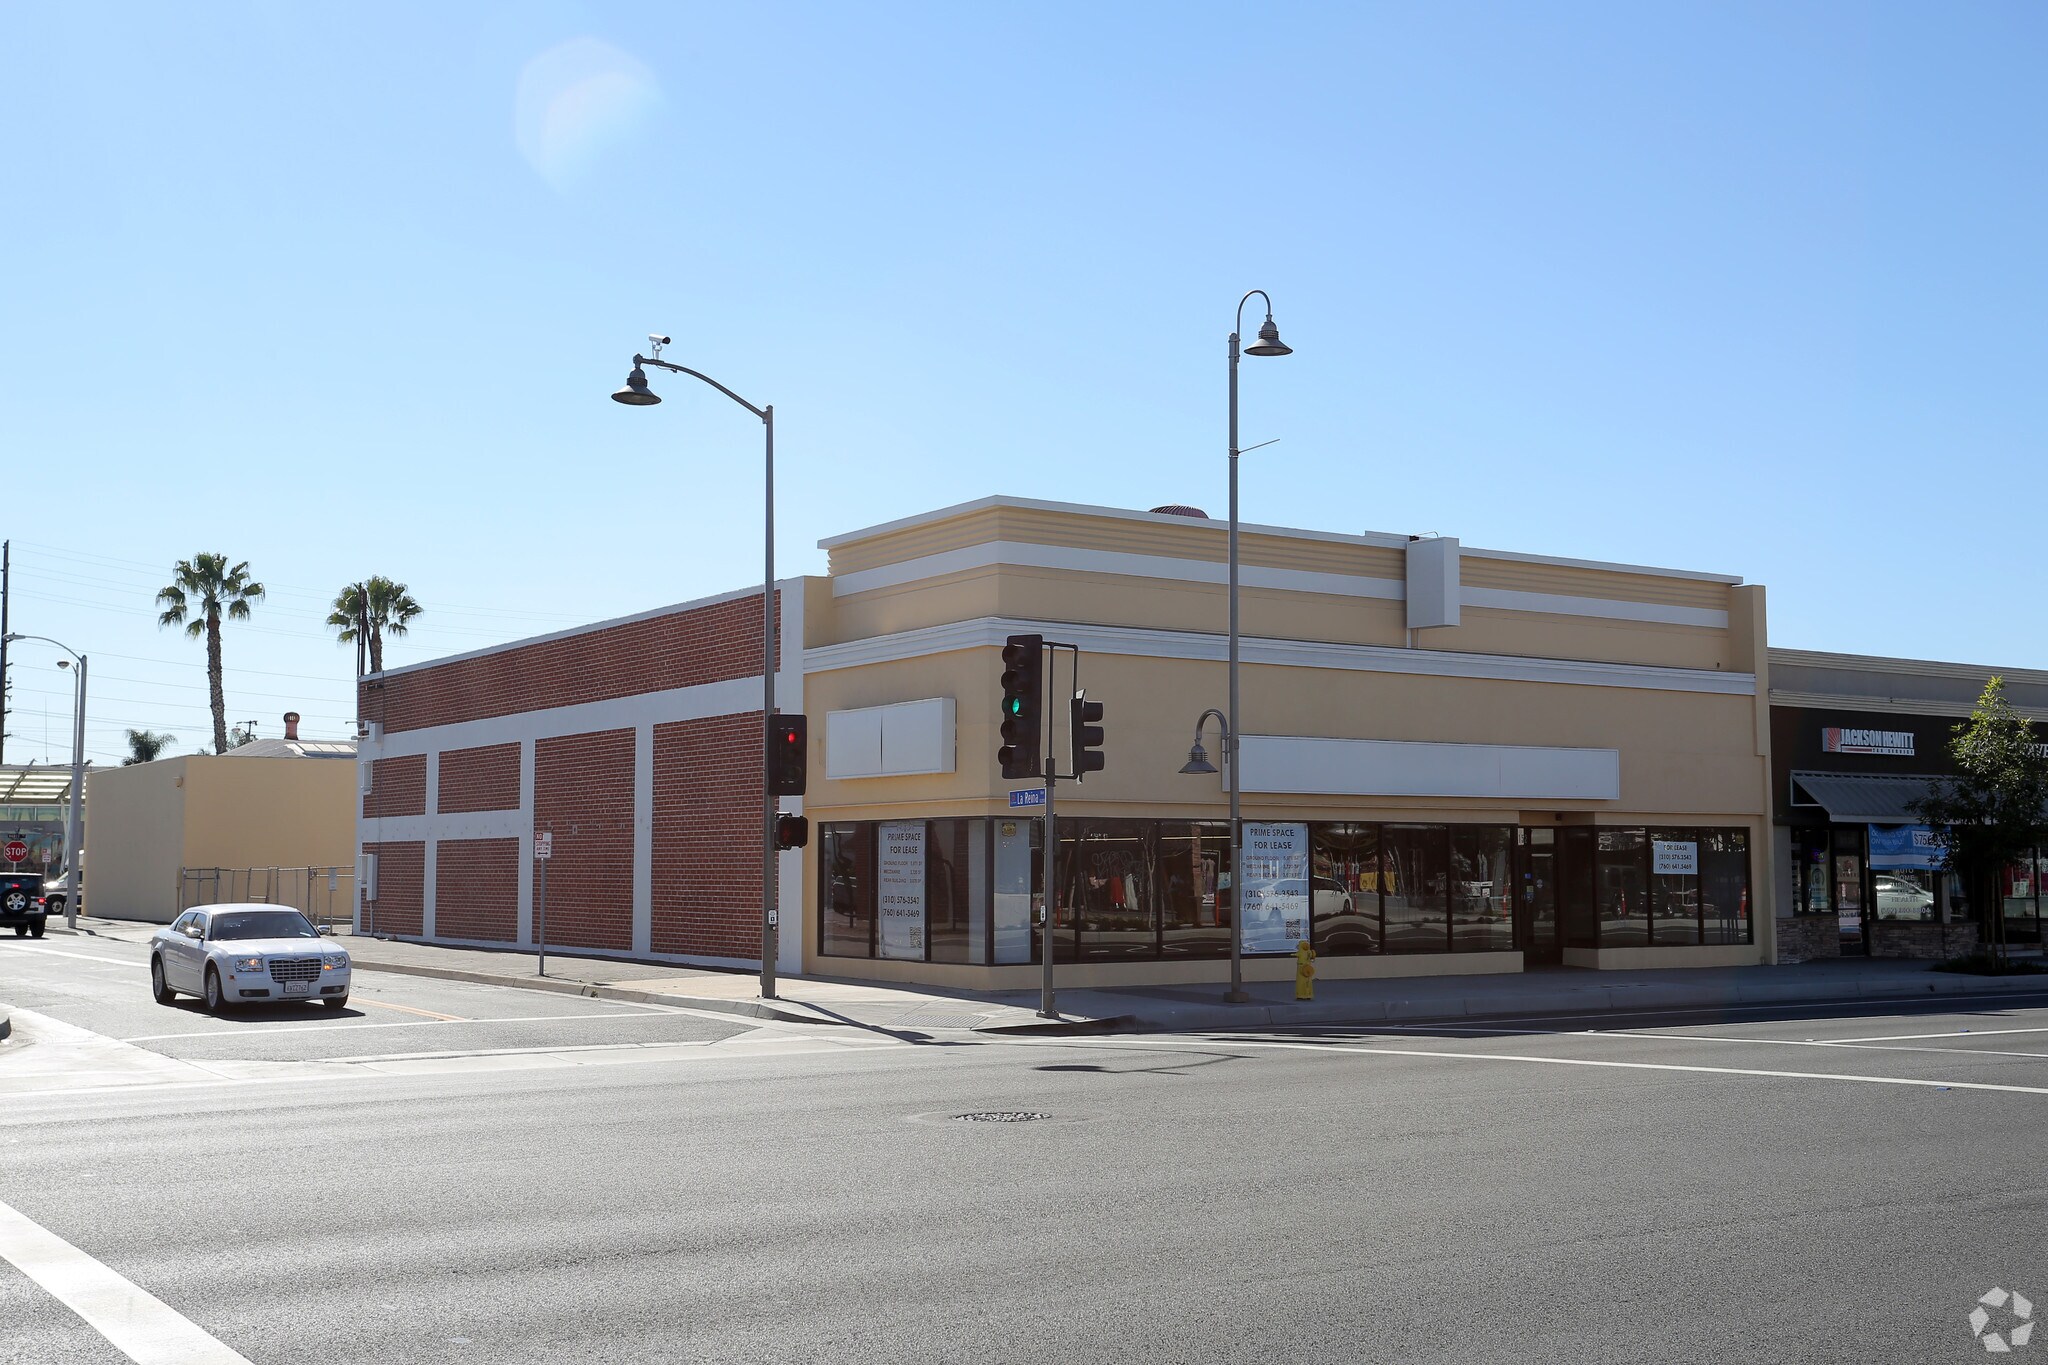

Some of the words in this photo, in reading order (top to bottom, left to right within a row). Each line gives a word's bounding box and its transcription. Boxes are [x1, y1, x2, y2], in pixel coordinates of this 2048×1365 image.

[1841, 729, 1881, 747] JACKSON
[1882, 731, 1914, 748] HEWITT
[1017, 792, 1023, 804] La
[1025, 792, 1038, 804] Reina
[887, 833, 904, 841] PRIME
[905, 833, 921, 841] SPACE
[1250, 828, 1271, 837] PRIME
[1272, 829, 1295, 837] SPACE
[890, 846, 901, 854] FOR
[902, 846, 918, 854] LEASE
[1254, 841, 1268, 849] FOR
[1270, 841, 1292, 850] LEASE
[5, 847, 27, 856] STOP
[1245, 889, 1265, 899] (310)
[1266, 890, 1299, 898] 576-3543
[883, 895, 896, 905] (310)
[1244, 902, 1263, 912] (760)
[1265, 903, 1299, 911] 641-5469
